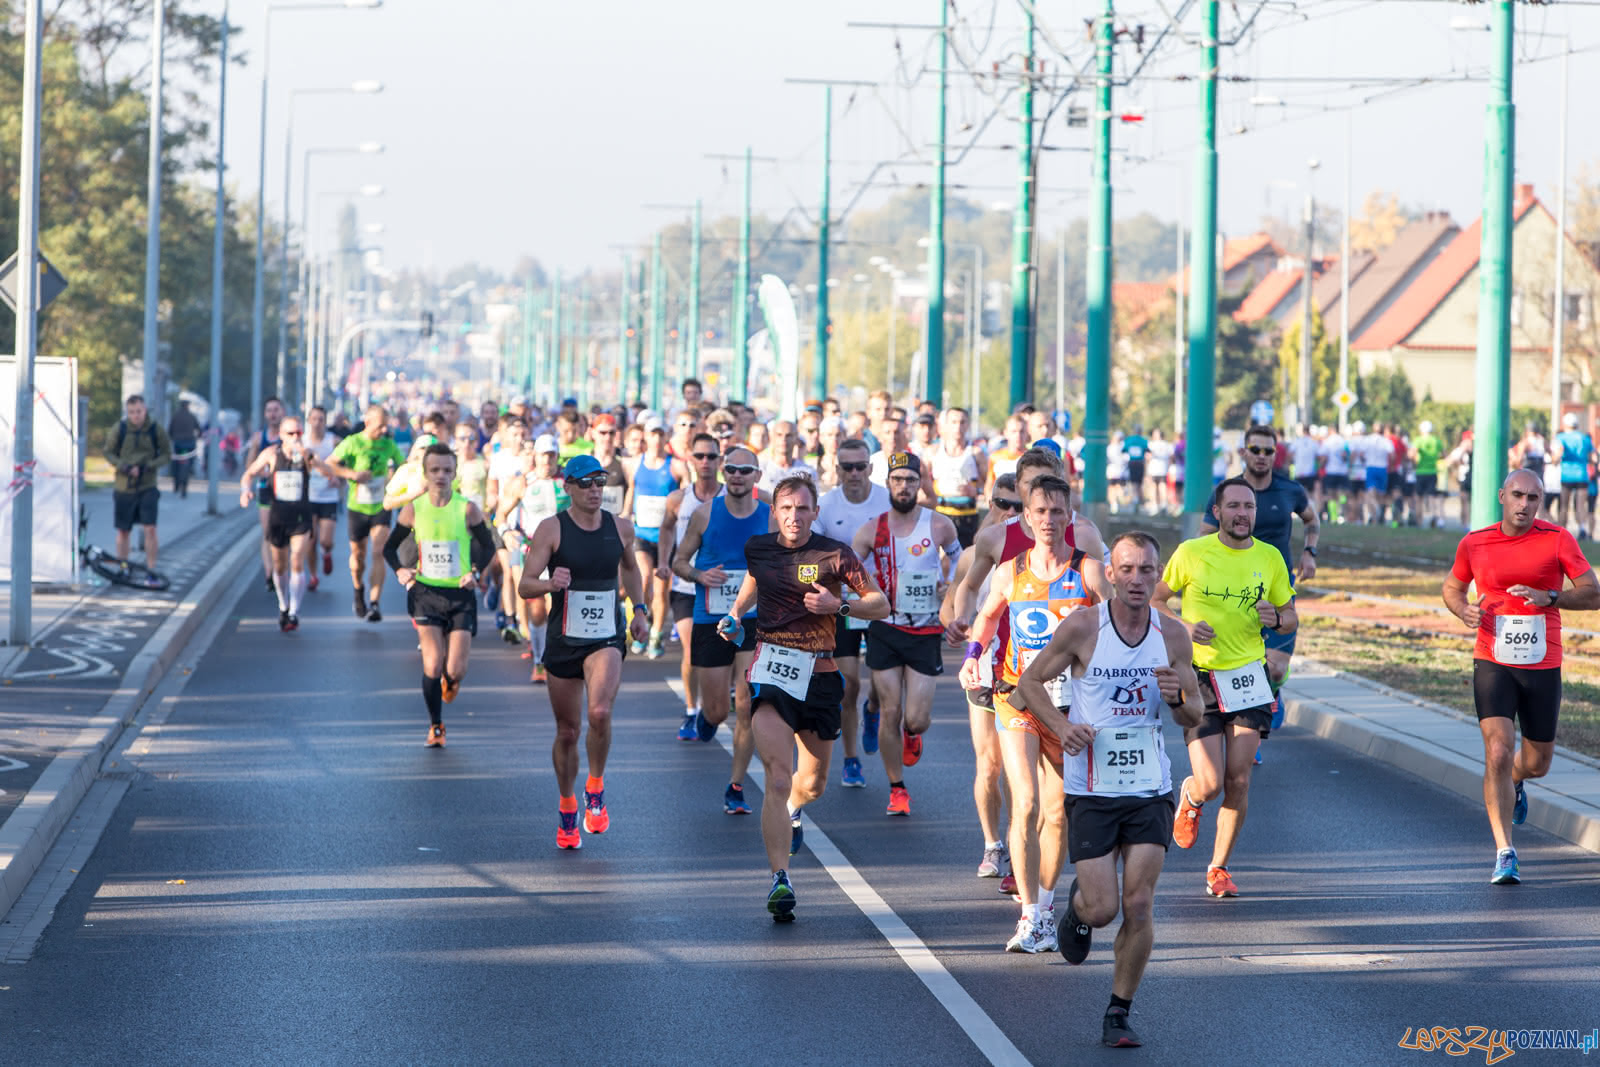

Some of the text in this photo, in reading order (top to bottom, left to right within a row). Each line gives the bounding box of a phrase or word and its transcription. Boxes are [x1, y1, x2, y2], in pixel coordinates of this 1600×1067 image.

[428, 553, 453, 563] 5352
[905, 585, 934, 597] 3833
[581, 607, 604, 619] 952
[1505, 632, 1538, 644] 5696
[766, 661, 800, 680] 1335
[1231, 674, 1255, 690] 889
[1112, 707, 1146, 716] TEAM
[1107, 749, 1145, 766] 2551
